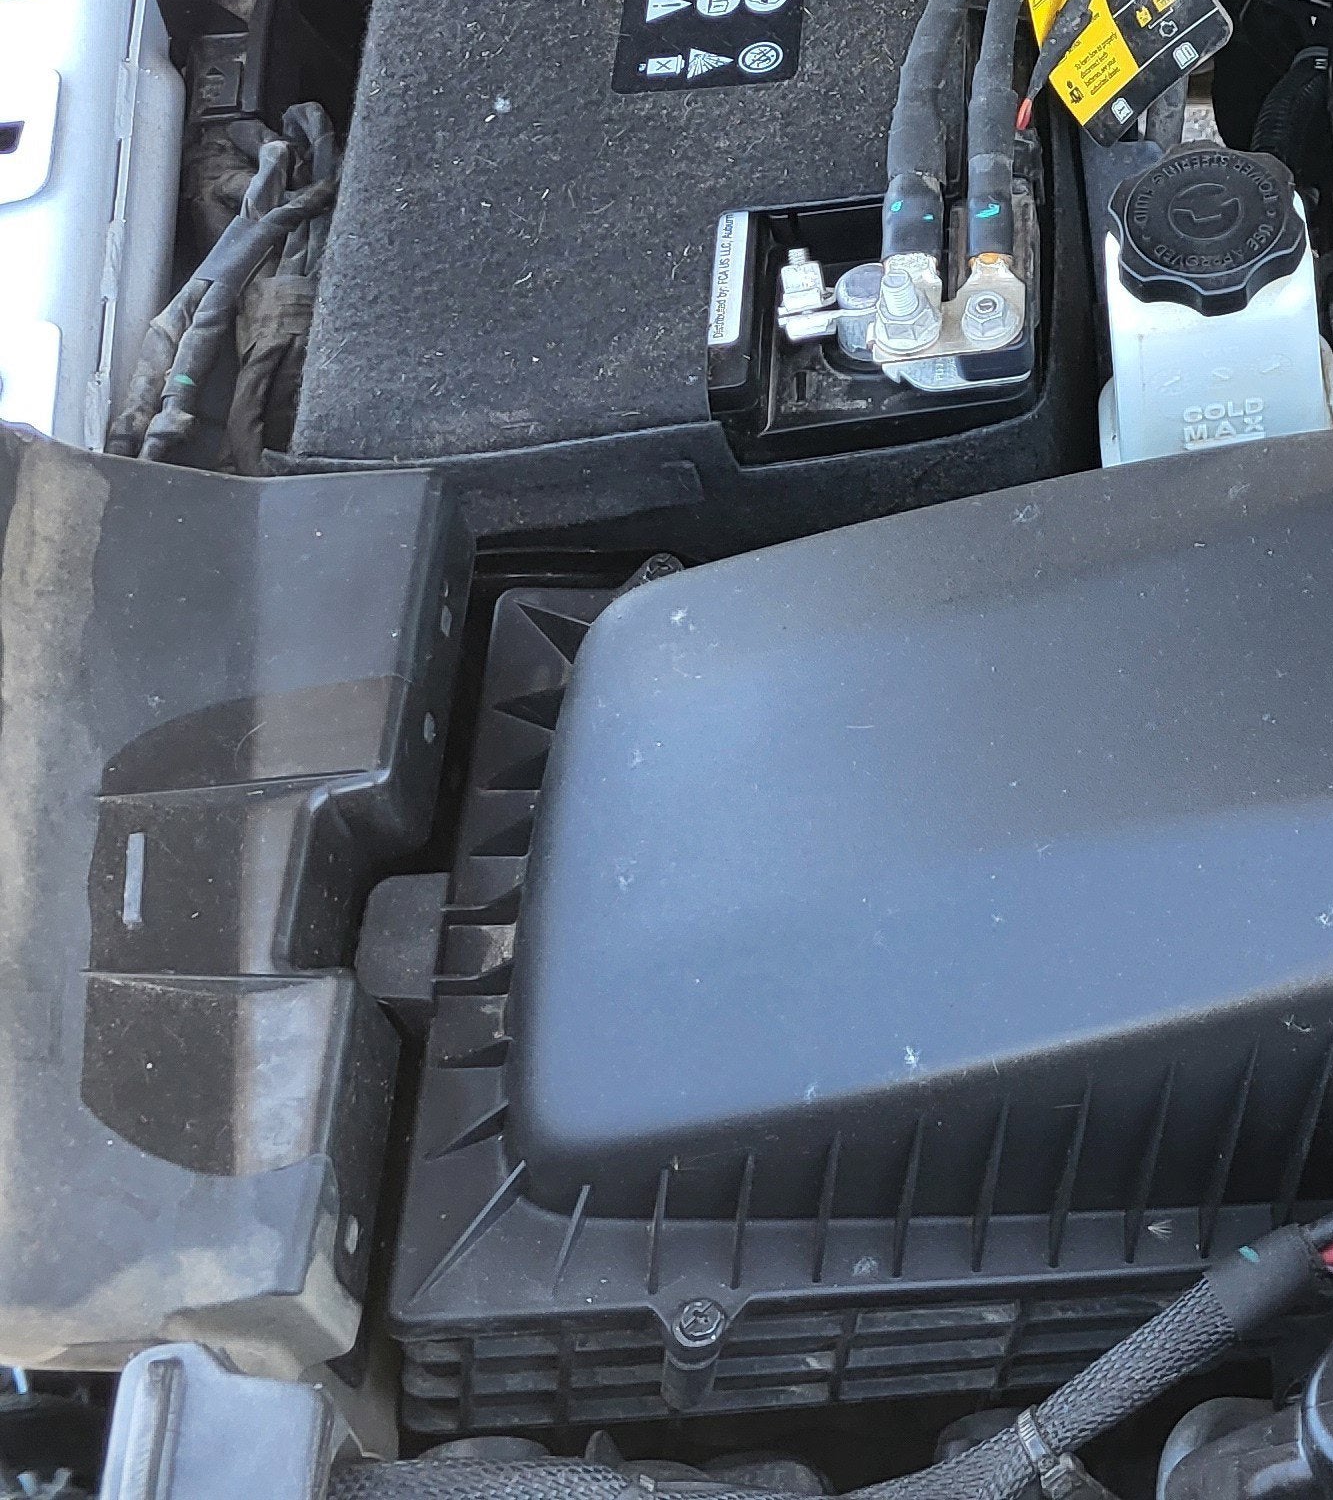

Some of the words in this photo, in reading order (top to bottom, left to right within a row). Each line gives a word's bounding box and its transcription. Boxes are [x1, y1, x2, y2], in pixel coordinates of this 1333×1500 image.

[1152, 154, 1230, 186] STEERING
[1233, 157, 1279, 202] POWER
[1249, 222, 1275, 252] USE
[719, 258, 731, 270] US
[1153, 242, 1246, 271] APPROVED
[718, 269, 730, 285] FCA
[1183, 397, 1265, 424] COLD
[1183, 414, 1265, 444] MAX
